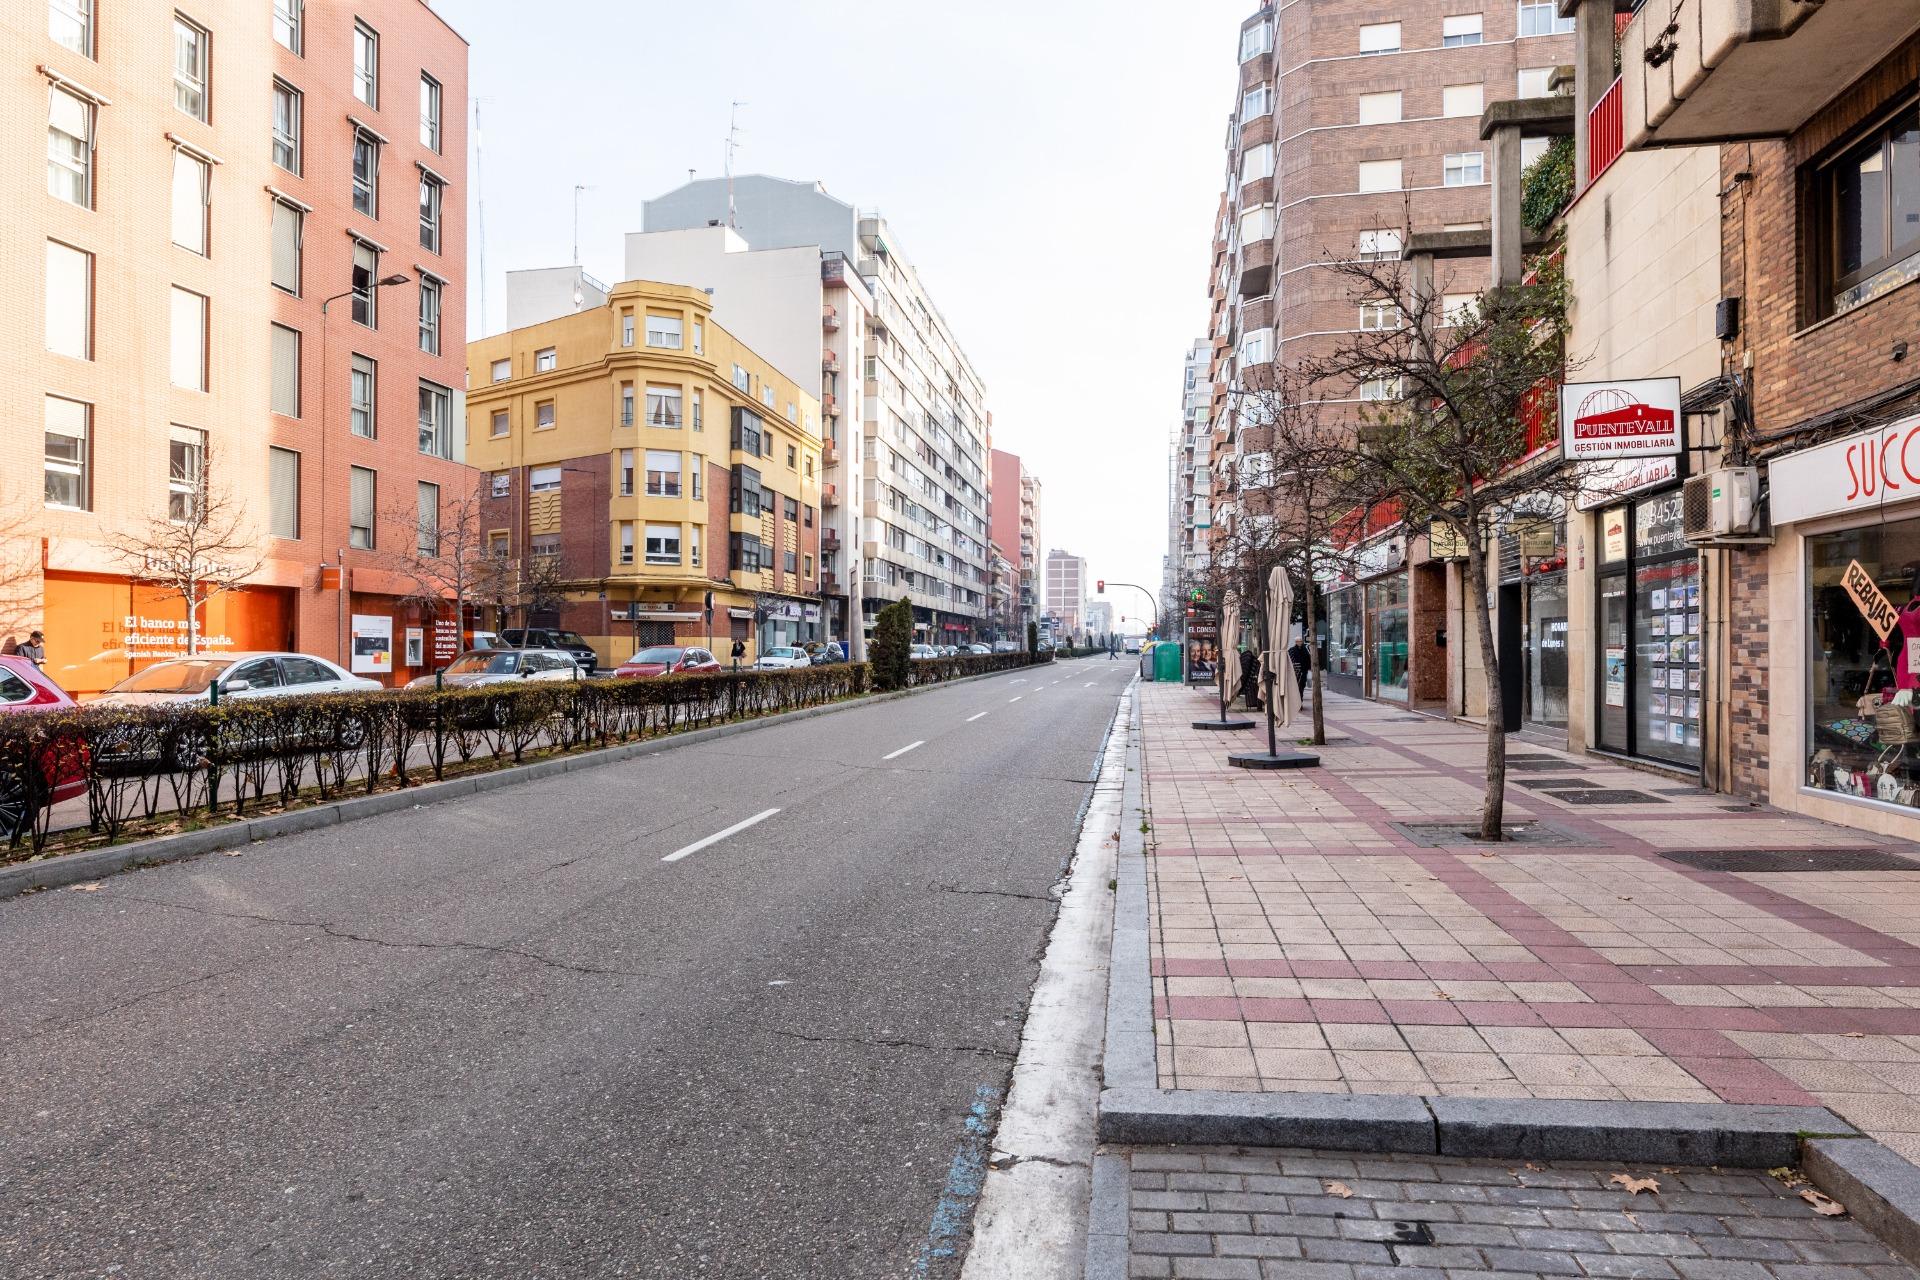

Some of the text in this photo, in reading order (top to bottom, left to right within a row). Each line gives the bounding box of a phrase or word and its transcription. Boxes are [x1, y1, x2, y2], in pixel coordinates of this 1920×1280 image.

[1574, 438, 1676, 452] GESTIÓN INMOBILIARIA
[1583, 463, 1670, 506] GESTI NMOBILIARIA
[1847, 563, 1896, 633] REBAJAS
[124, 615, 200, 630] El banco ms
[124, 632, 175, 645] eficiente
[177, 633, 189, 645] de
